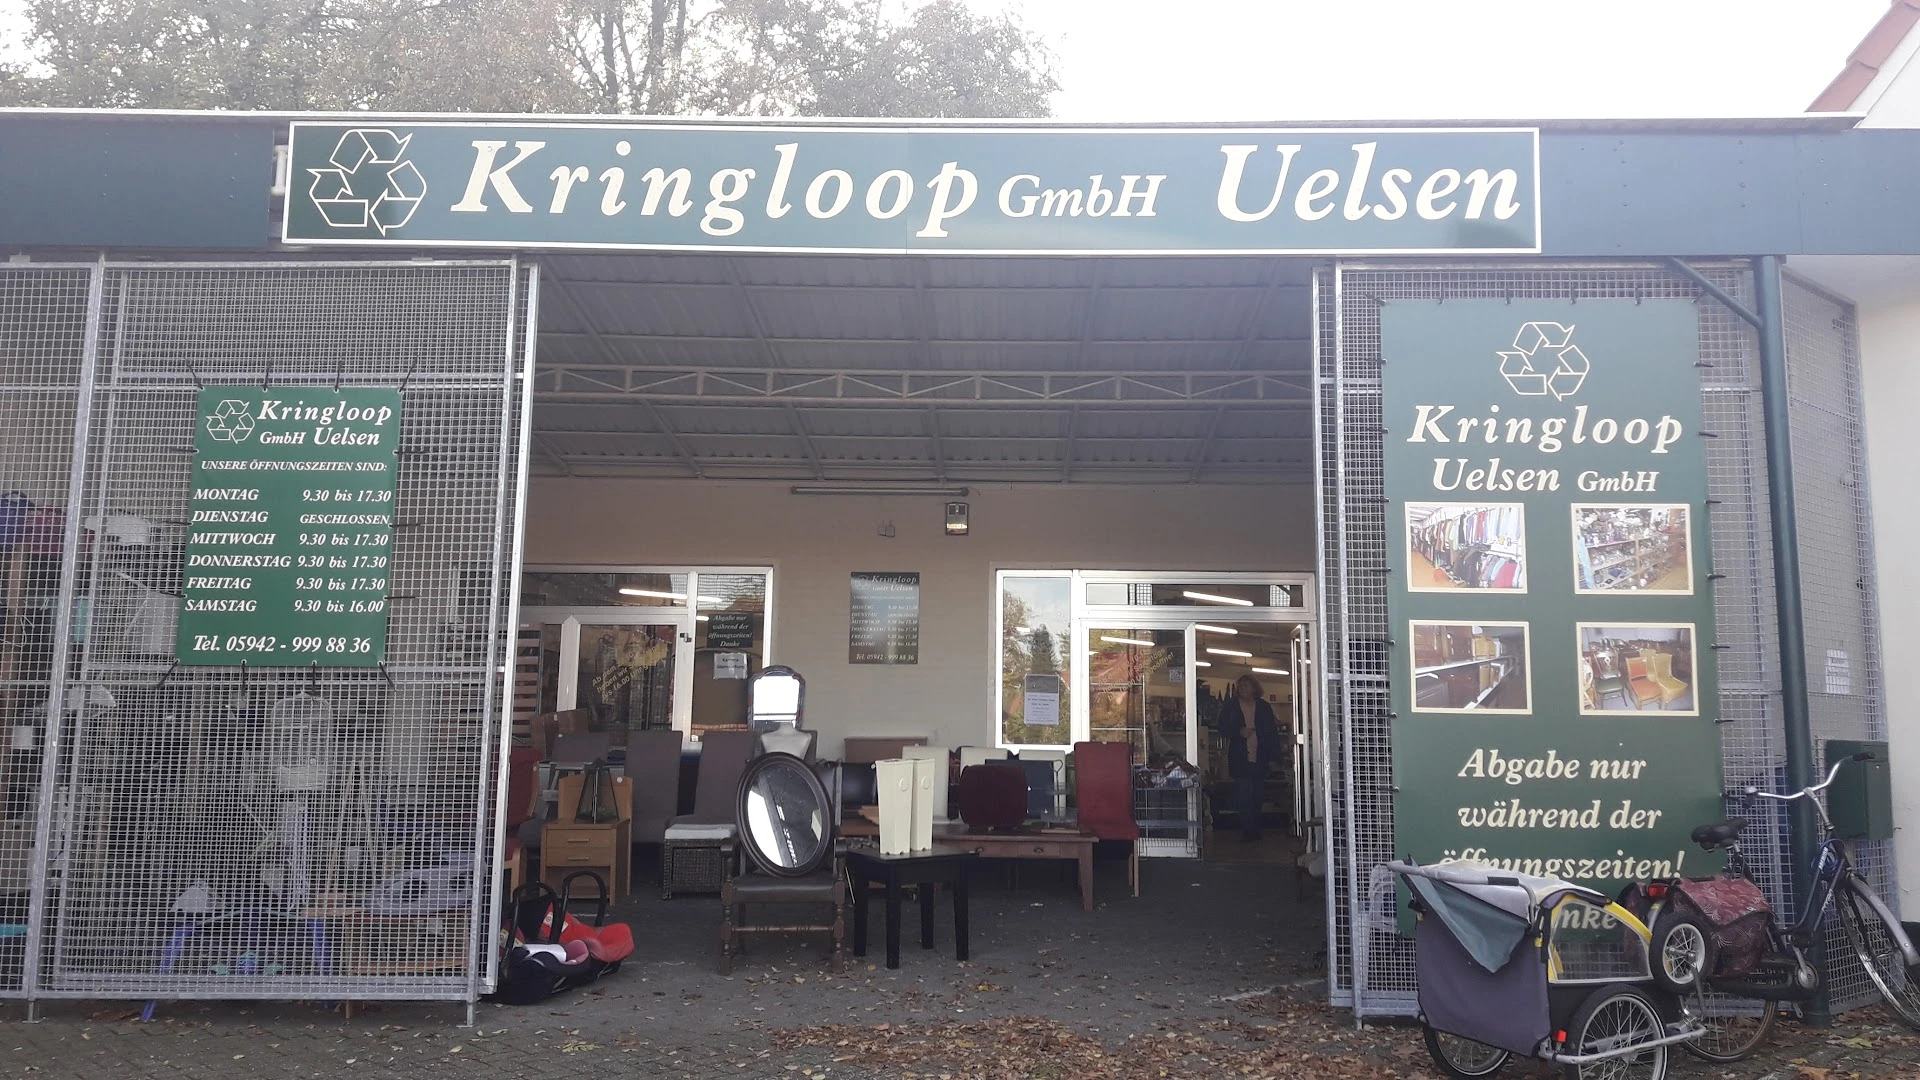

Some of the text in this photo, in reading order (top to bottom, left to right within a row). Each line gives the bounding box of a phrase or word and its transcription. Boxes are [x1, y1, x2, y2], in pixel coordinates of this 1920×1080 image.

[450, 140, 1521, 239] Kringloop GmbH Uelsen
[257, 400, 392, 425] Kringloop
[259, 427, 380, 445] GmbH Uelsen
[1407, 405, 1683, 454] Kringloop
[201, 458, 387, 472] UNSERE ÖFFNUNGSZEITEN SIND:
[1432, 458, 1660, 493] Uelsen GmbH
[193, 488, 391, 502] MONTAG 9.30 bis 17.30
[191, 510, 390, 525] DIENSTAG GESCHLOSSEN
[190, 532, 388, 547] MITTWOCH 9.30 bis 17.30
[188, 555, 387, 569] DONNERSTAG 9.30 bis 17.30
[186, 577, 385, 591] FREITAG 9.30 bis 17.30
[871, 575, 917, 585] Kringloop
[185, 599, 384, 613] SAMSTAG 9.30 bis 16.00
[192, 635, 221, 652] Tel.
[225, 636, 276, 653] 05942
[292, 636, 322, 654] 999
[325, 636, 346, 654] 88
[349, 637, 371, 654] 36
[1458, 748, 1647, 785] Abgabe nur
[1457, 798, 1662, 829] während der
[1562, 904, 1617, 930] nke
